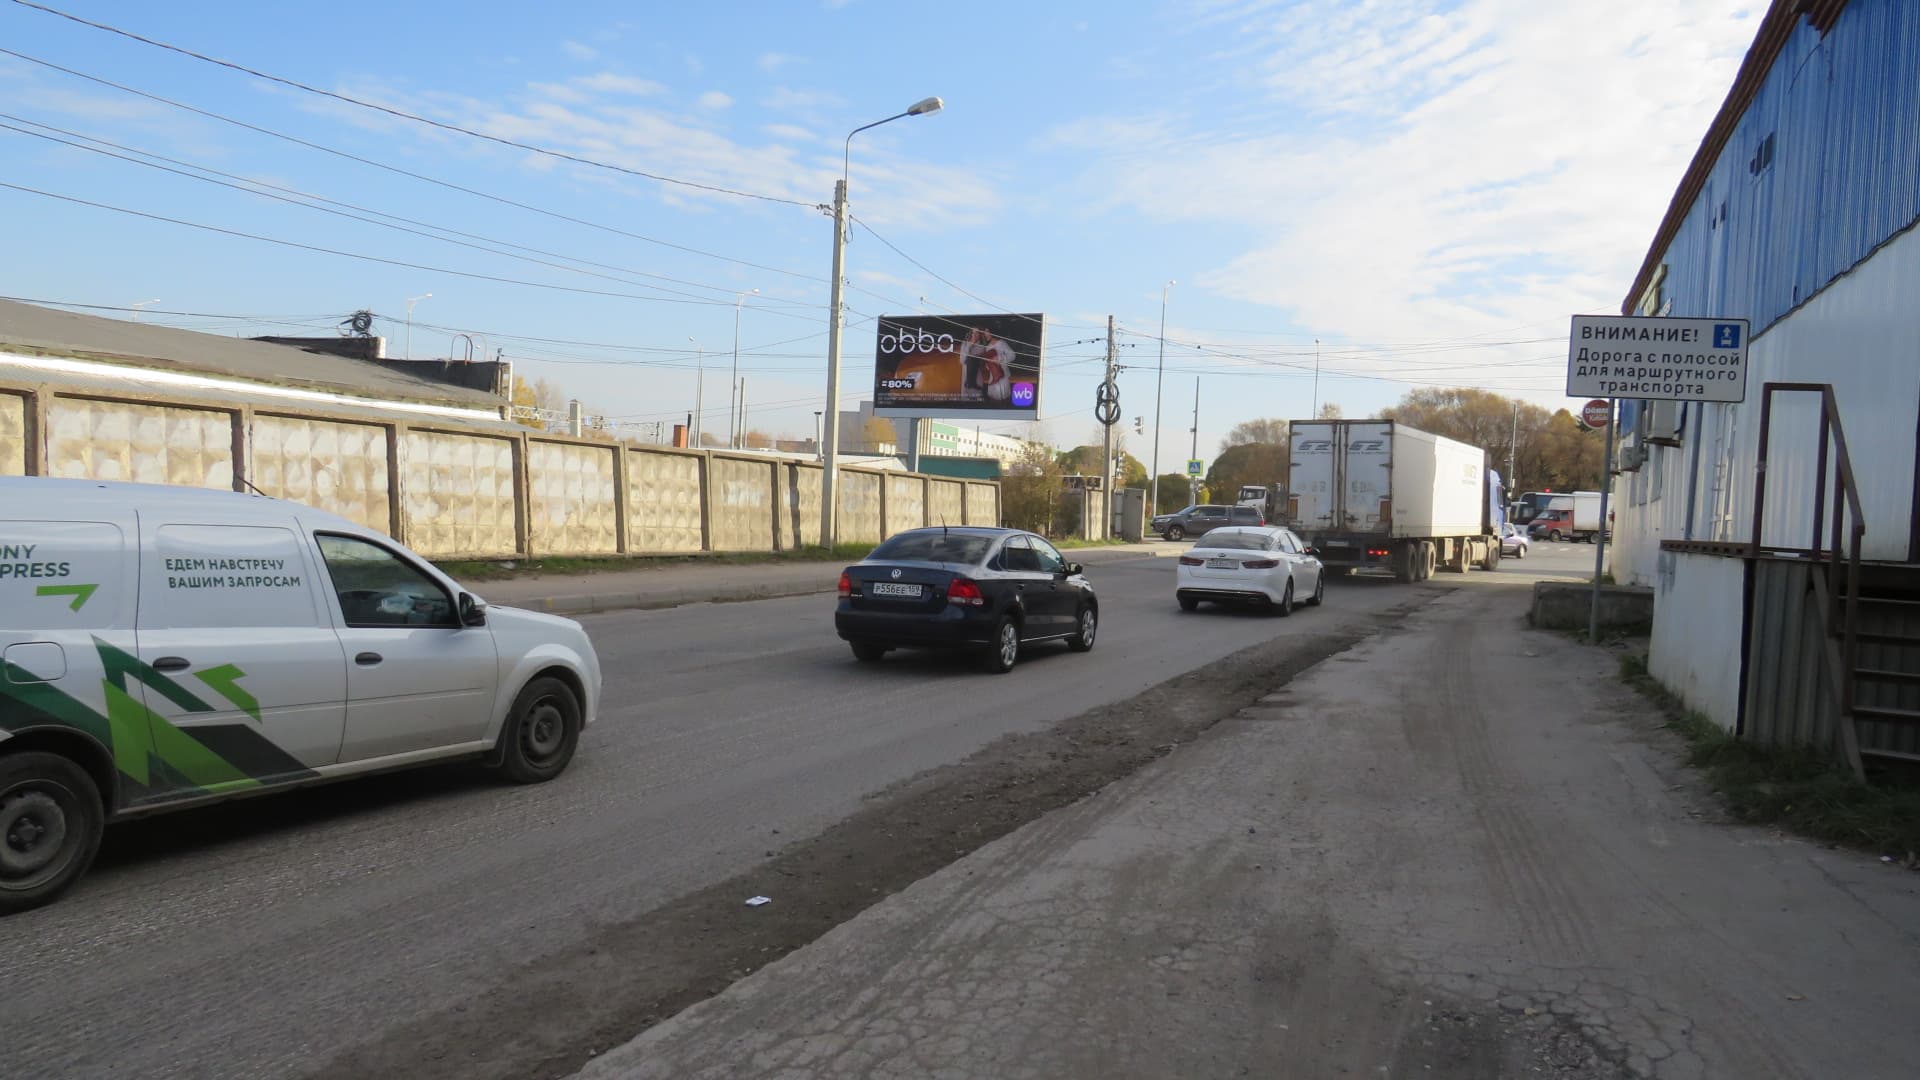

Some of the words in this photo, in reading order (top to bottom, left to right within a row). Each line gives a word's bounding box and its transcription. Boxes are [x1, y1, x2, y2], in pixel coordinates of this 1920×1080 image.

[1582, 326, 1699, 342] ВНИМАНИЕ!
[1577, 348, 1642, 365] Дорога
[1647, 353, 1656, 363] с
[1662, 352, 1740, 366] полосой
[1577, 366, 1608, 377] для
[1614, 367, 1737, 382] маршрутного
[1013, 388, 1033, 400] wb
[1599, 380, 1704, 396] транспорта
[0, 544, 36, 559] NY
[165, 558, 206, 571] ЕДЕМ
[208, 559, 285, 571] НАВСТРЕЧУ
[168, 577, 224, 588] ВАШИМ
[228, 576, 301, 588] ЗАПРОСАМ
